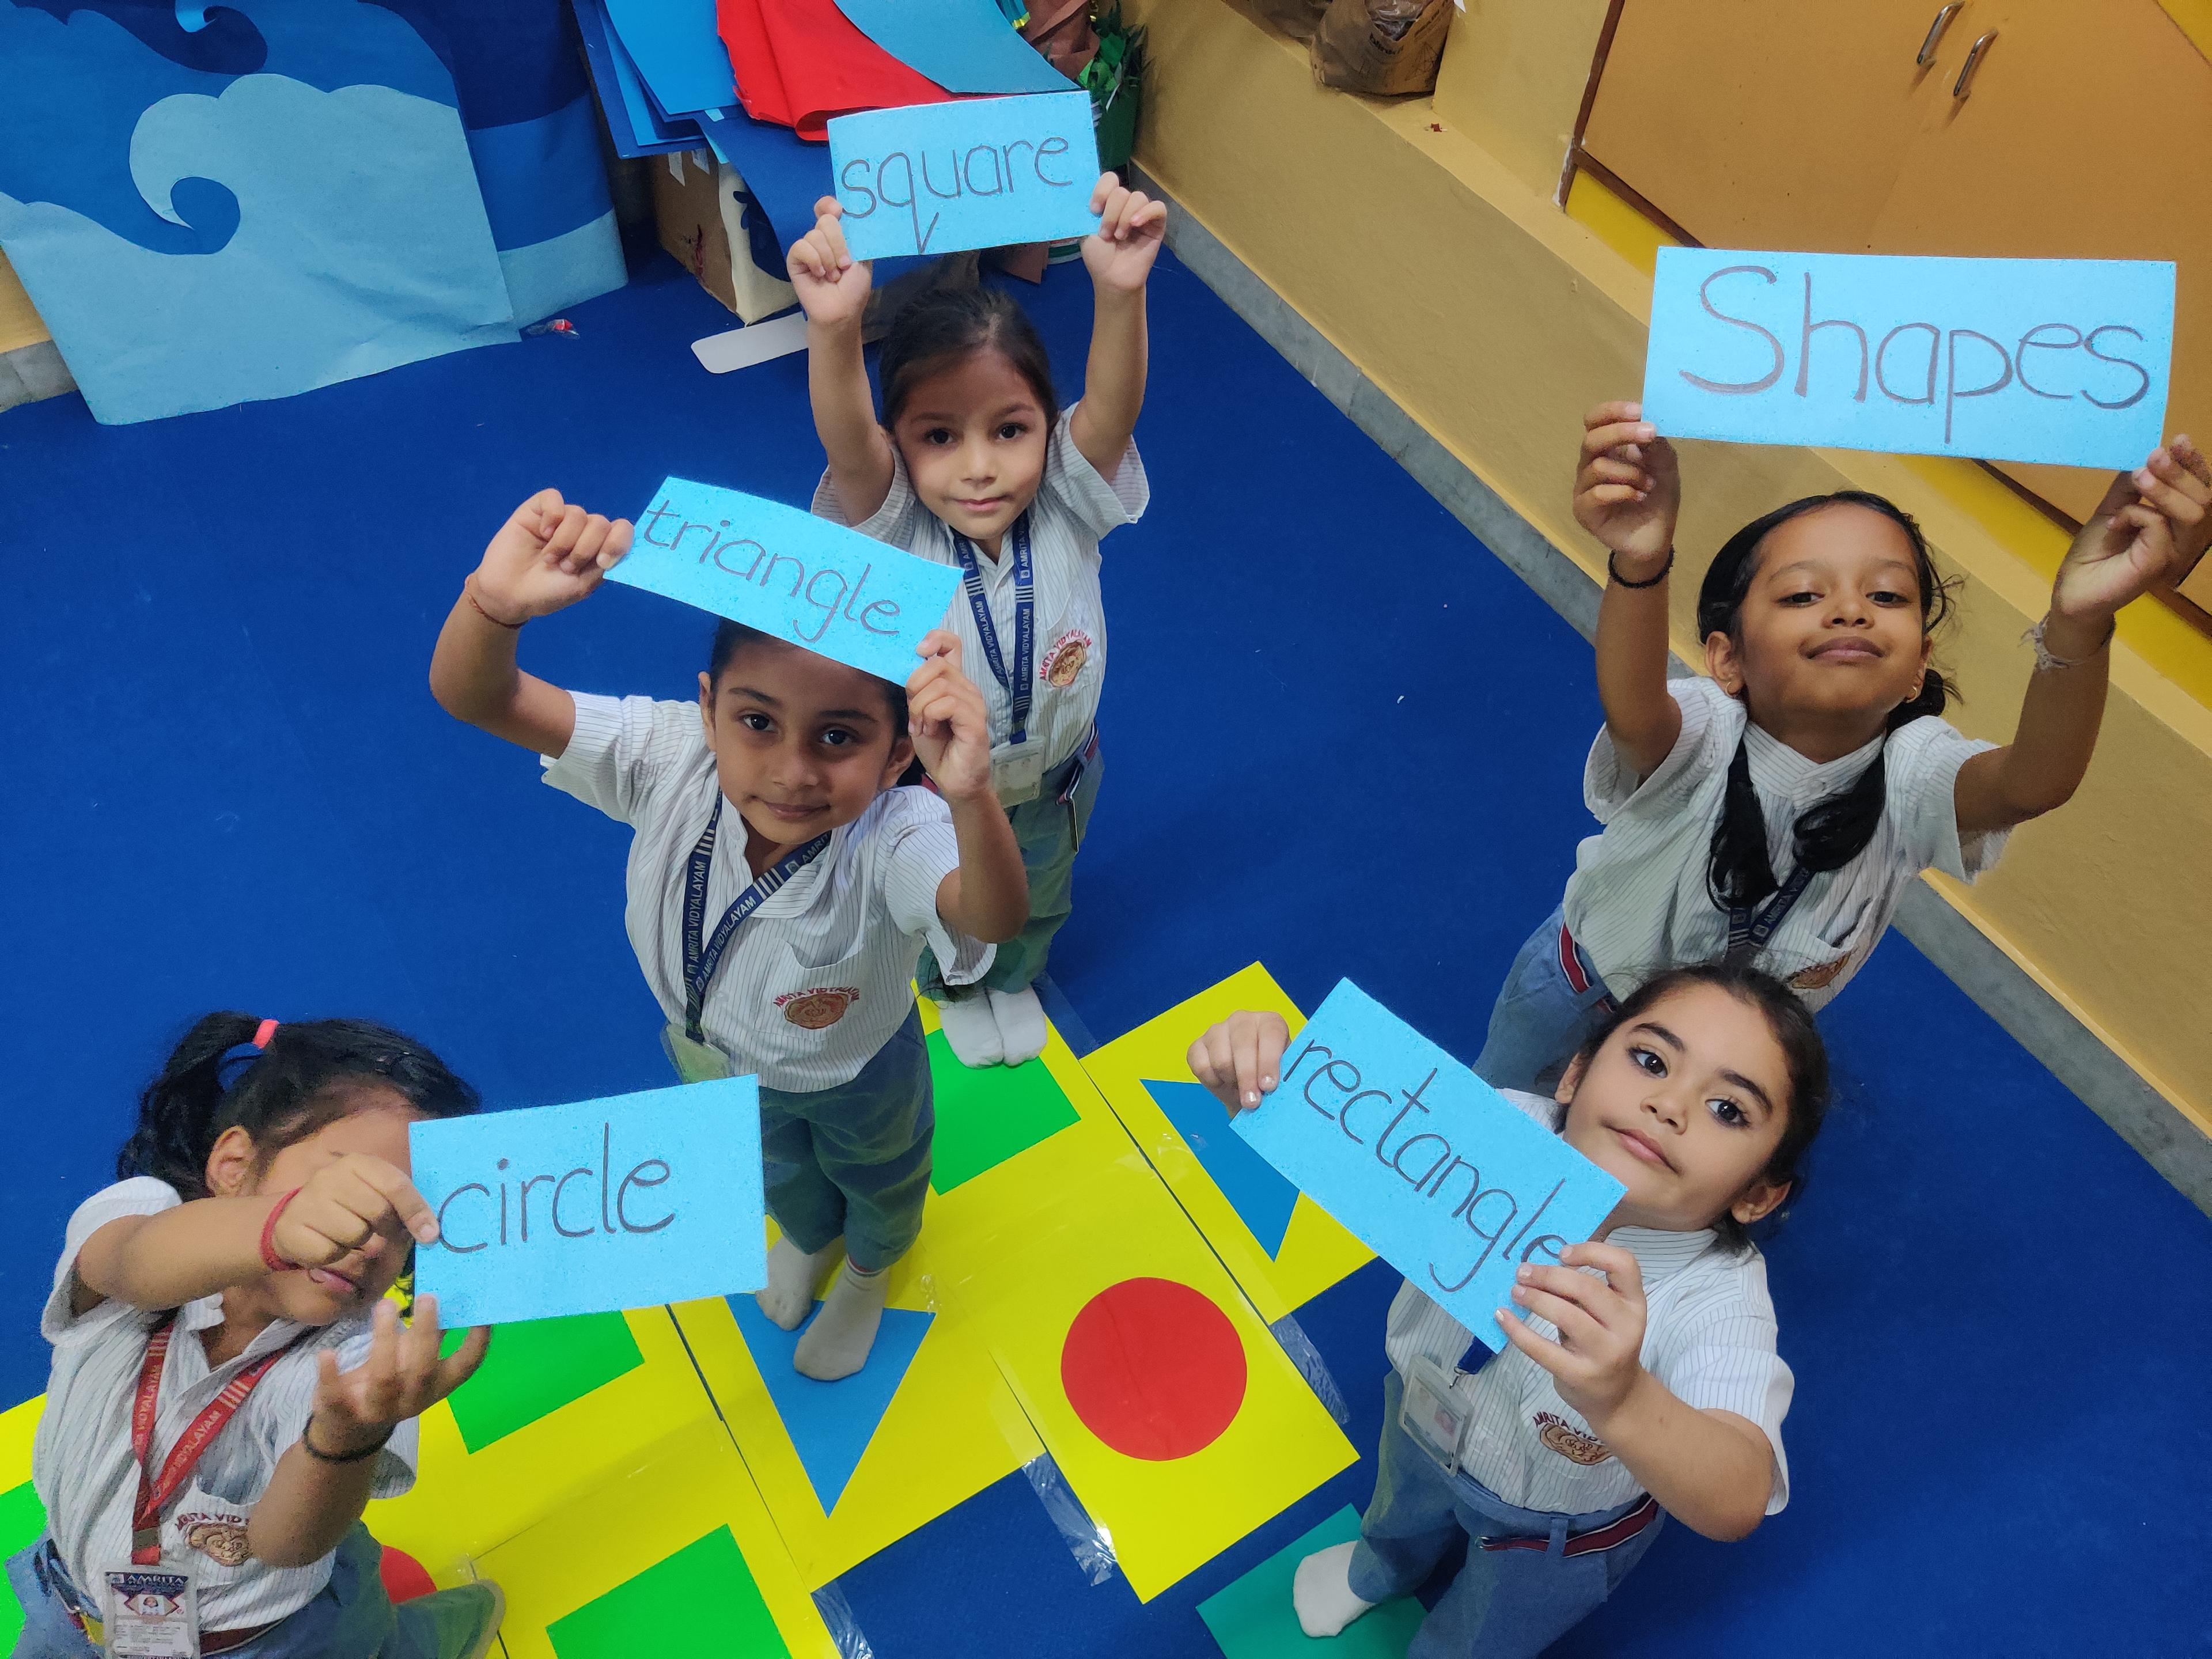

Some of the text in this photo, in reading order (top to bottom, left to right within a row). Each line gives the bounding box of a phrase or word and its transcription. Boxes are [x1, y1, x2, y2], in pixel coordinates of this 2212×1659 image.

[841, 137, 1073, 255] square
[1679, 264, 2150, 444] Shapes
[643, 499, 901, 643] triangle
[976, 600, 995, 648] VIDYALAYAM
[1021, 608, 1030, 681] AMRITA VIDYALAYAM
[688, 860, 707, 963] AMRITA VIDYALAYAM
[702, 895, 757, 980] AMRITA VIDYALAYAM
[437, 1122, 677, 1253] circle
[1282, 1039, 1569, 1293] rectangle
[1532, 1411, 1570, 1429] AMRITA
[126, 1574, 185, 1585] AMRITA
